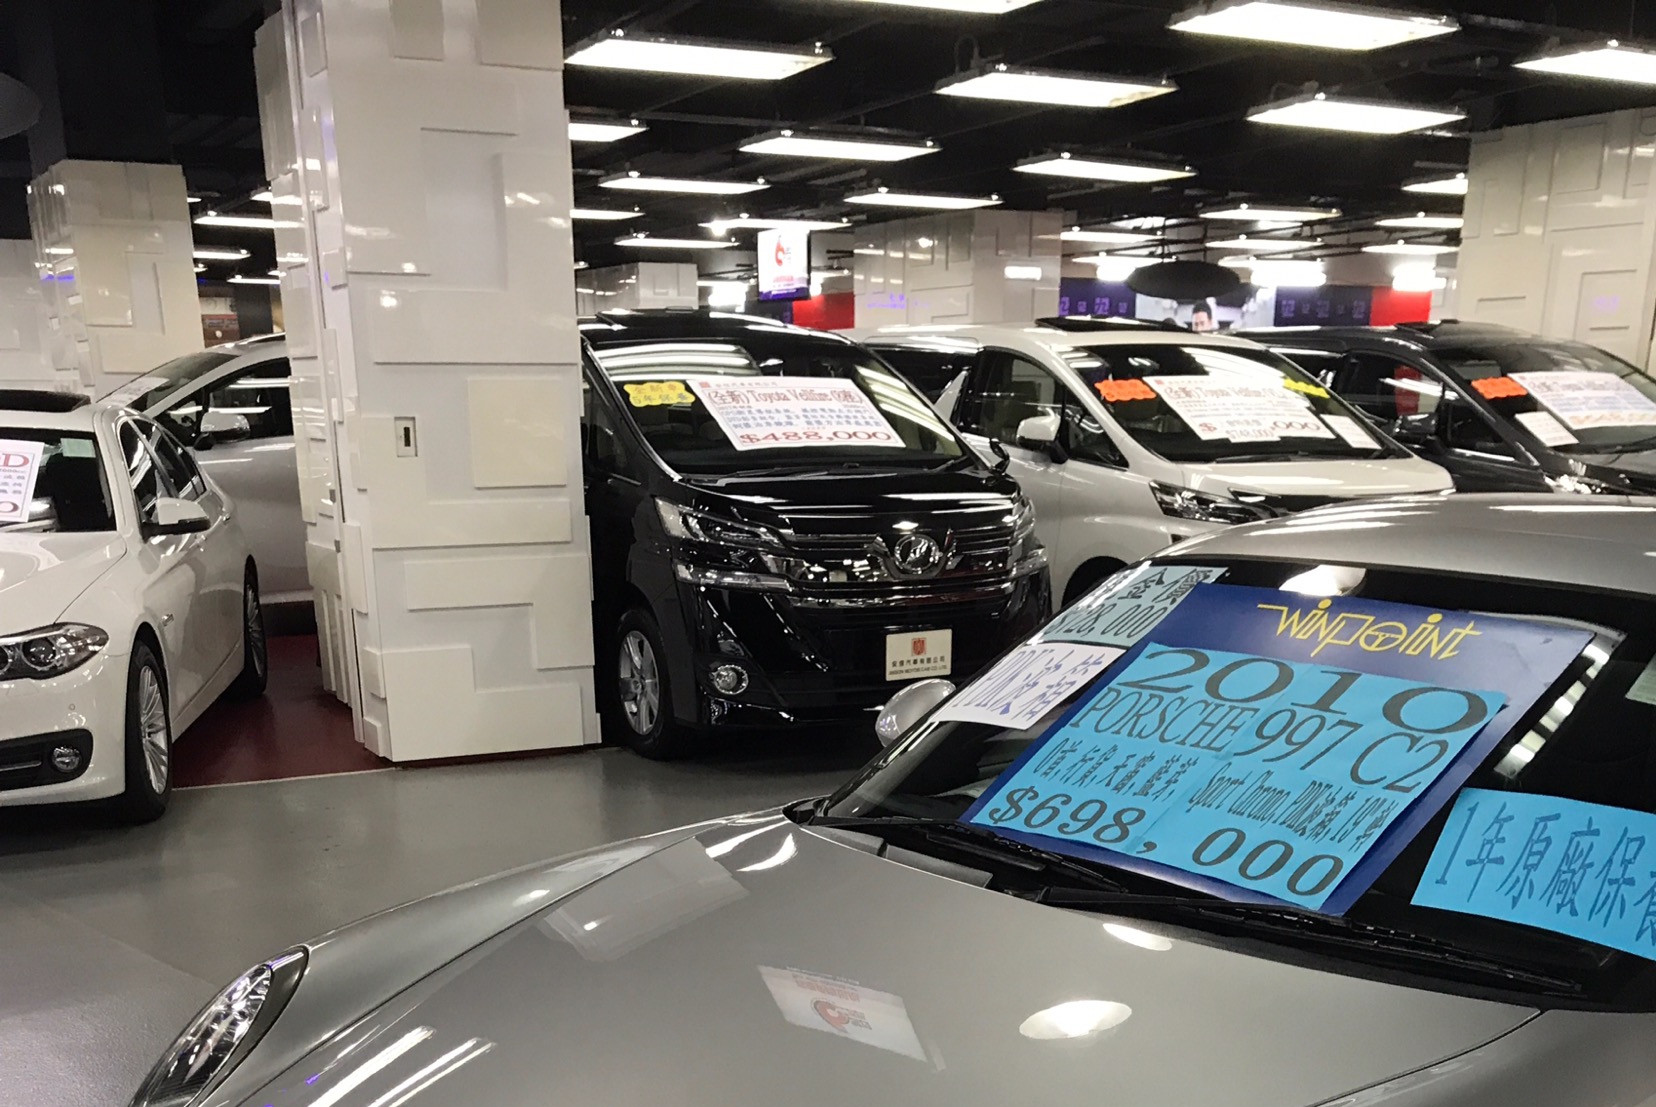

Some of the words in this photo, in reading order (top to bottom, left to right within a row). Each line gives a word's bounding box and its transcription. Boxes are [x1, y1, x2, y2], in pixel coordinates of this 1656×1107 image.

[740, 431, 892, 443] $488,000
[1116, 648, 1488, 734] 2010
[1069, 687, 1260, 752] PORSCHE
[1232, 708, 1364, 771] 997
[1349, 732, 1449, 794] C2
[1186, 761, 1253, 813] Sport
